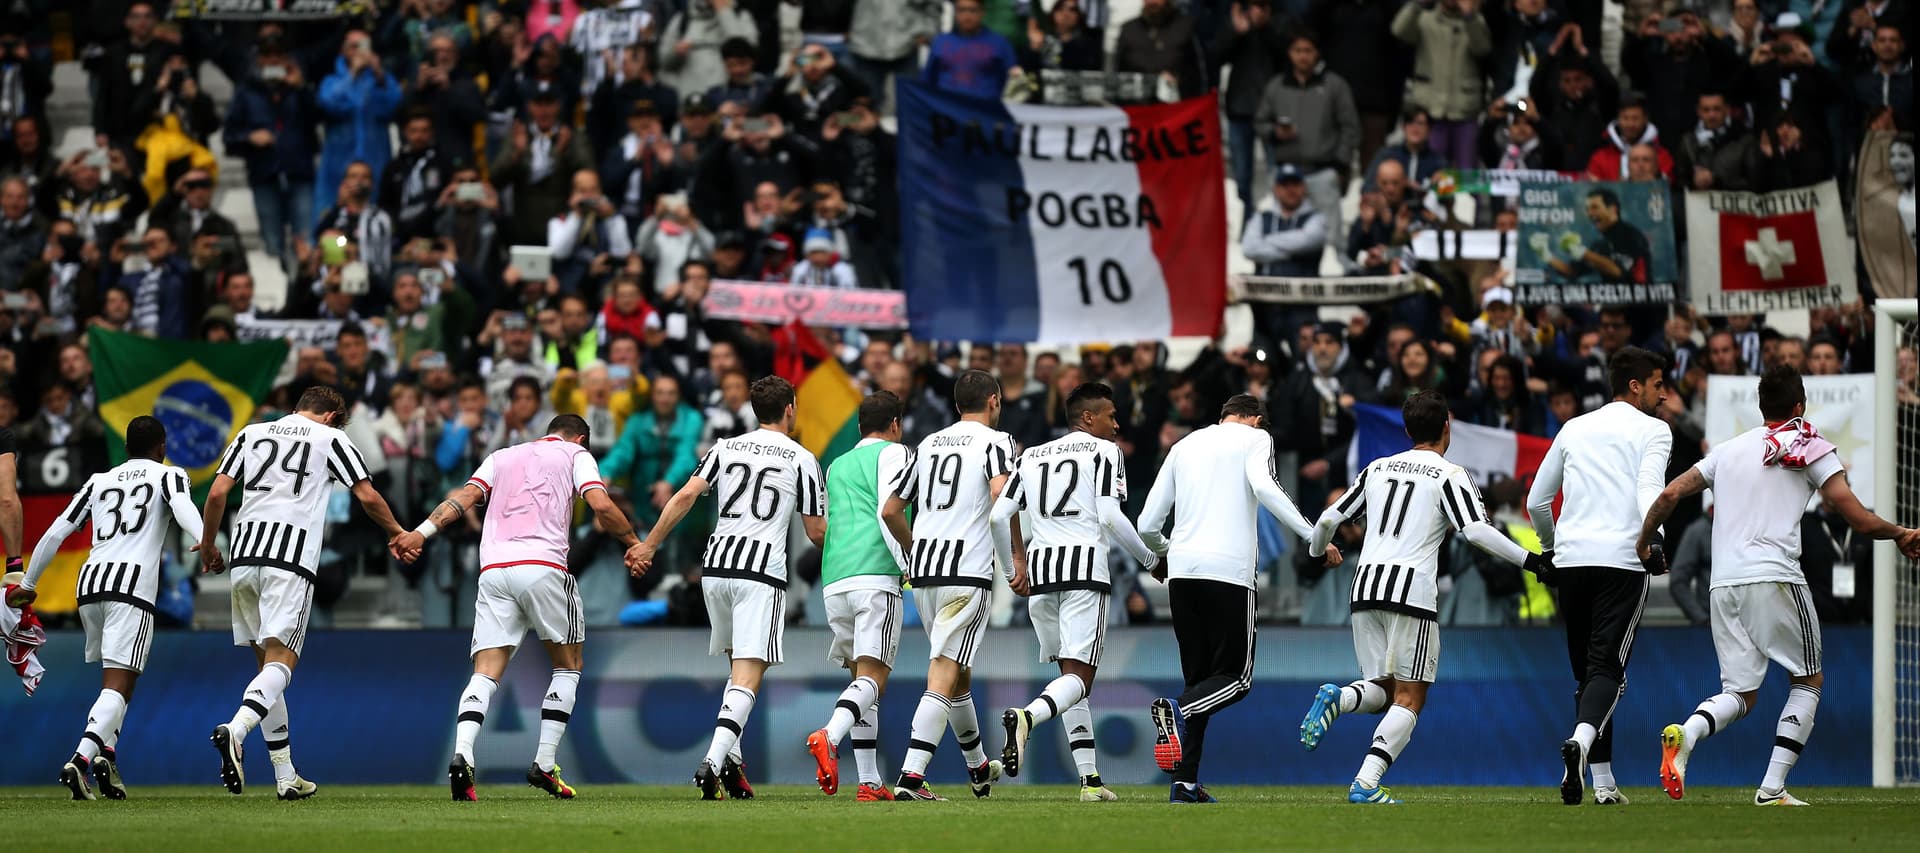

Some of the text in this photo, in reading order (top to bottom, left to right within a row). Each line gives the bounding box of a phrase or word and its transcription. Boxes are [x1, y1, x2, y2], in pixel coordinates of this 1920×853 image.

[930, 111, 1211, 163] PAUL LABILE
[1006, 186, 1163, 230] POGBA
[1523, 188, 1559, 206] GIGI
[1518, 207, 1575, 225] UFFON
[1066, 256, 1133, 306] 10
[1562, 284, 1588, 303] UNA
[1589, 284, 1633, 302] SCELTA
[1634, 284, 1647, 301] DI
[1648, 283, 1675, 302] VITA
[1706, 284, 1843, 311] LICHTSTEINER
[267, 424, 311, 437] RUGANI
[931, 435, 974, 448] BONUCCI
[725, 440, 797, 462] LICHTSTEINER
[1028, 441, 1098, 460] ALEX SANDRO
[41, 449, 71, 488] 6
[117, 468, 147, 482] EVRA
[245, 438, 313, 497] 24
[925, 452, 963, 512] 19
[1373, 462, 1384, 473] A.
[1385, 461, 1444, 480] HERNANES
[719, 462, 782, 521] 26
[1037, 458, 1082, 519] 12
[96, 482, 154, 541] 33
[1378, 478, 1416, 538] 11
